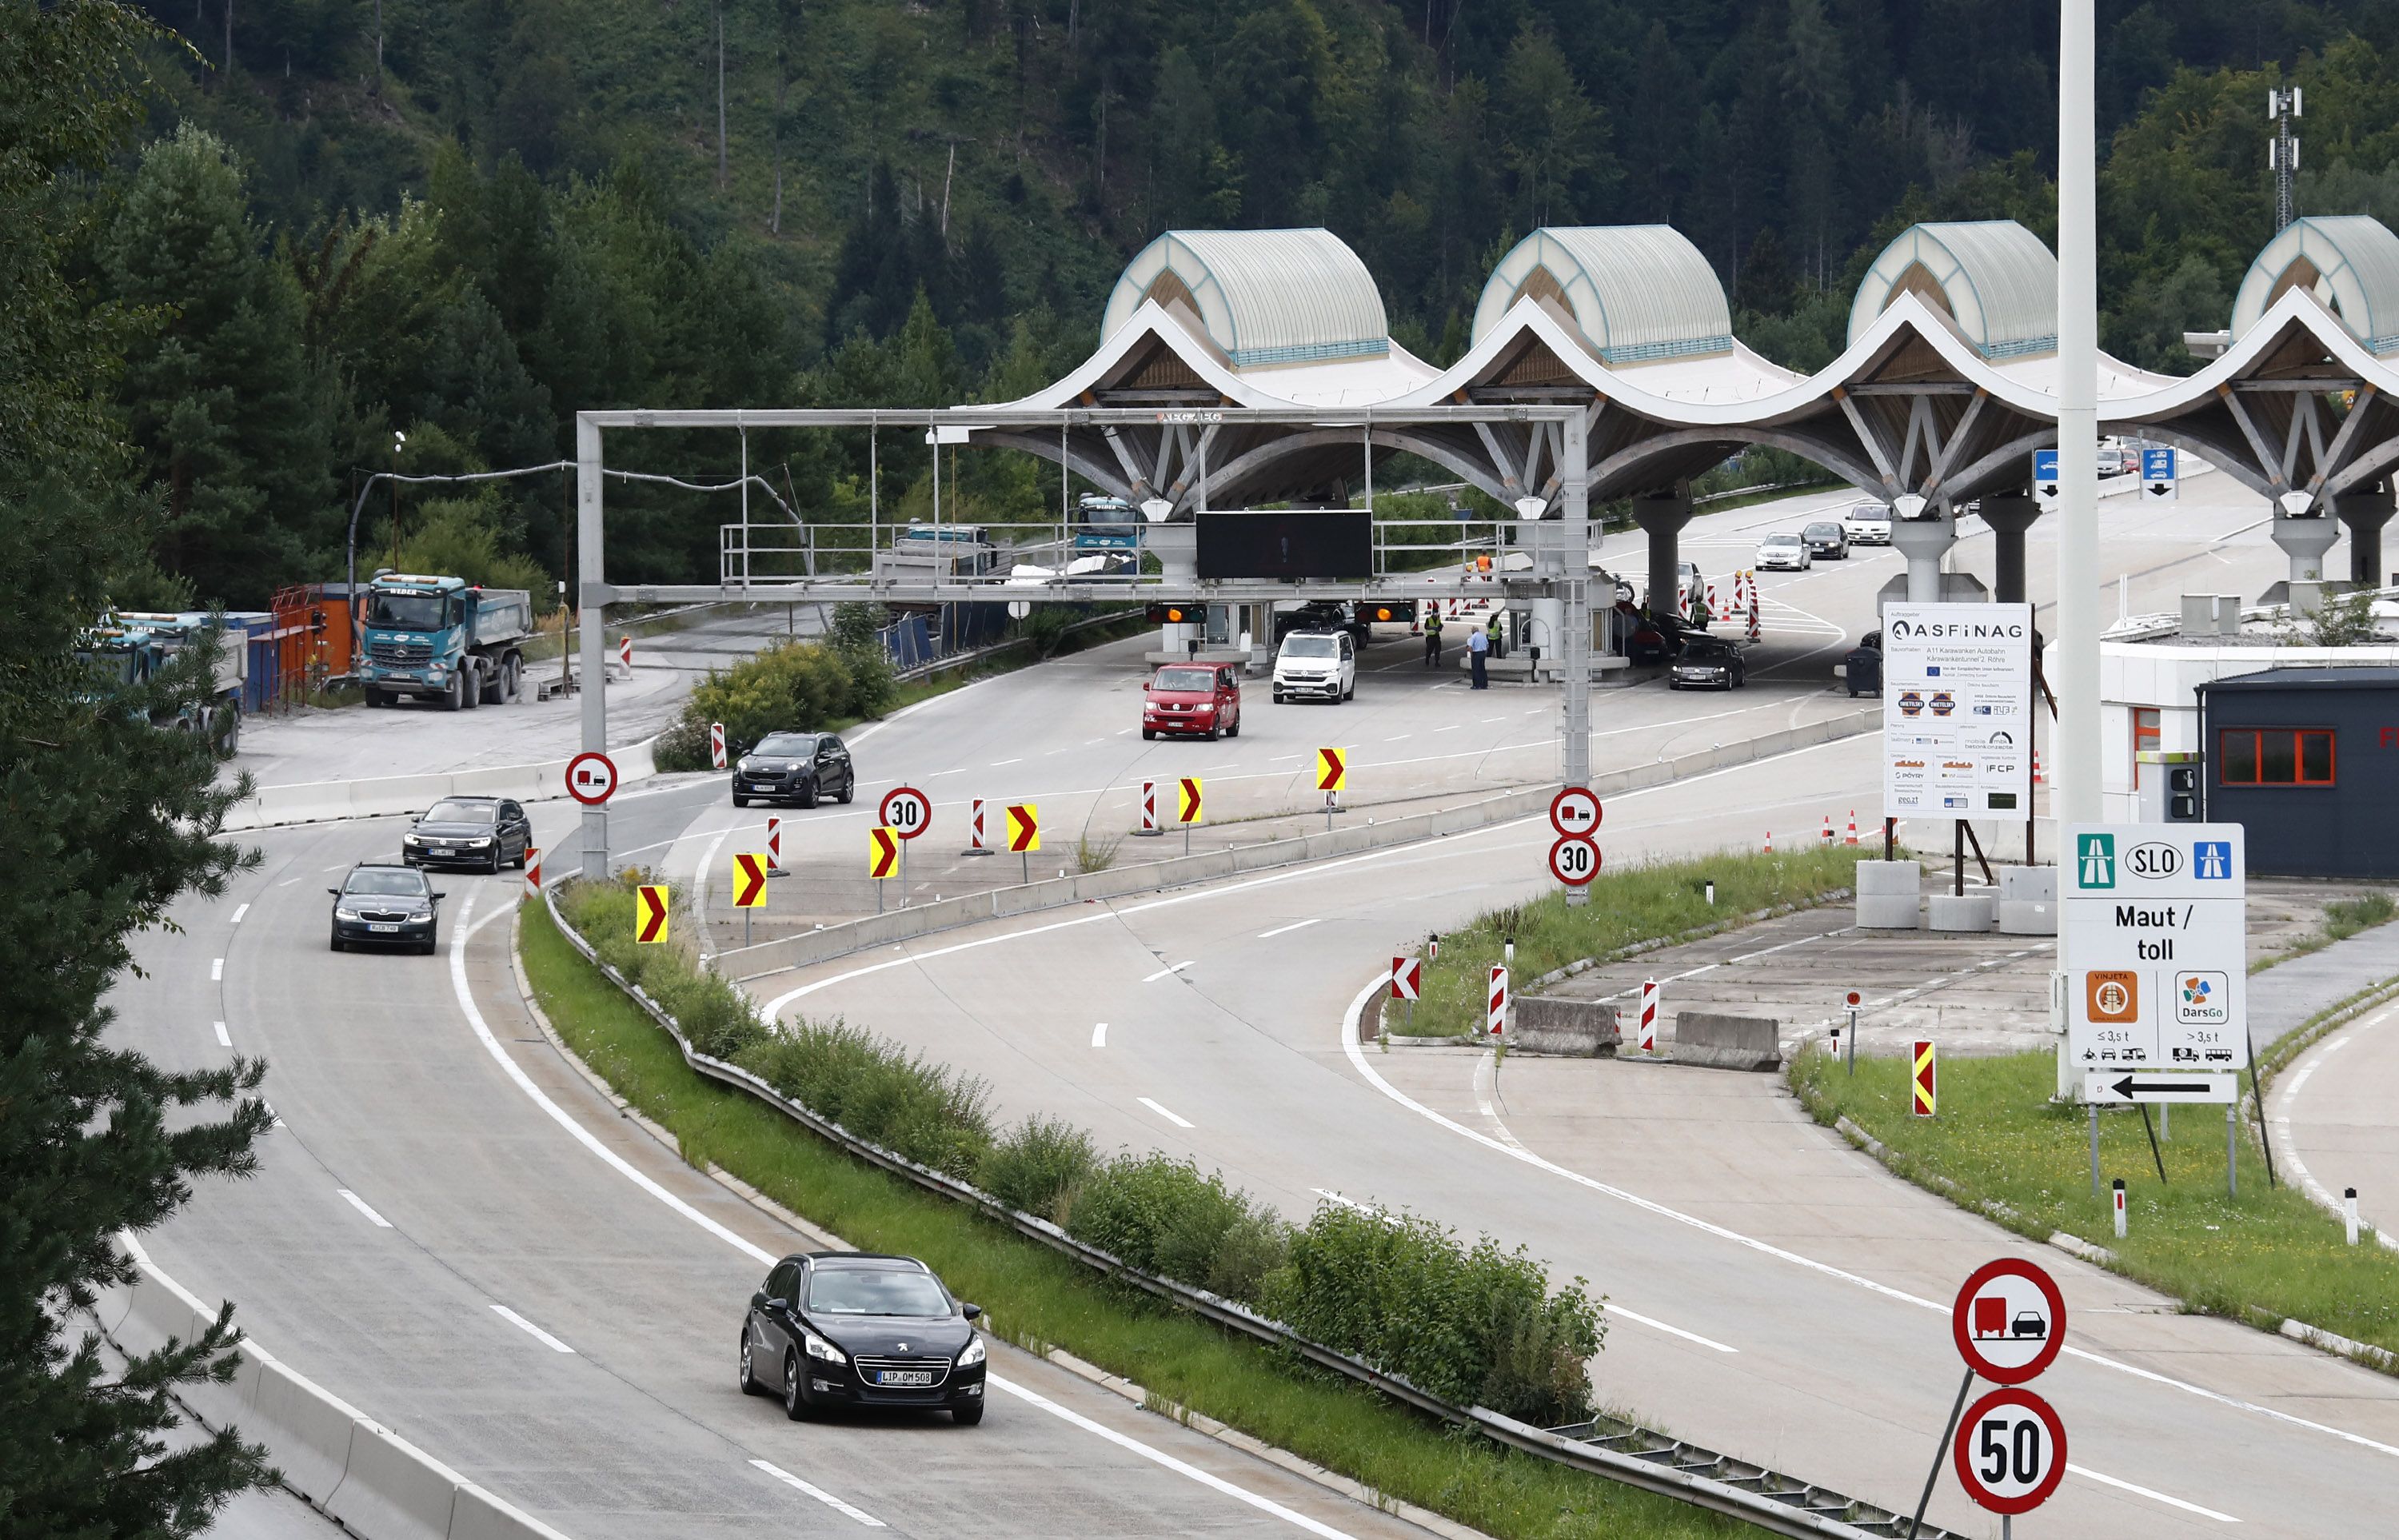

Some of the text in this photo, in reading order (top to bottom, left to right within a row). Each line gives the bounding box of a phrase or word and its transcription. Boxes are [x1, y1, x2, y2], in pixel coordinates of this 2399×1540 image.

[892, 800, 916, 826] 30
[1563, 847, 1587, 872] 30
[2134, 849, 2175, 873] SLO
[2116, 905, 2176, 927] Maut
[2138, 939, 2173, 960] toll
[2183, 1007, 2223, 1018] DarsGo
[883, 1372, 930, 1382] LIP OM 508
[1981, 1419, 2040, 1484] 50
